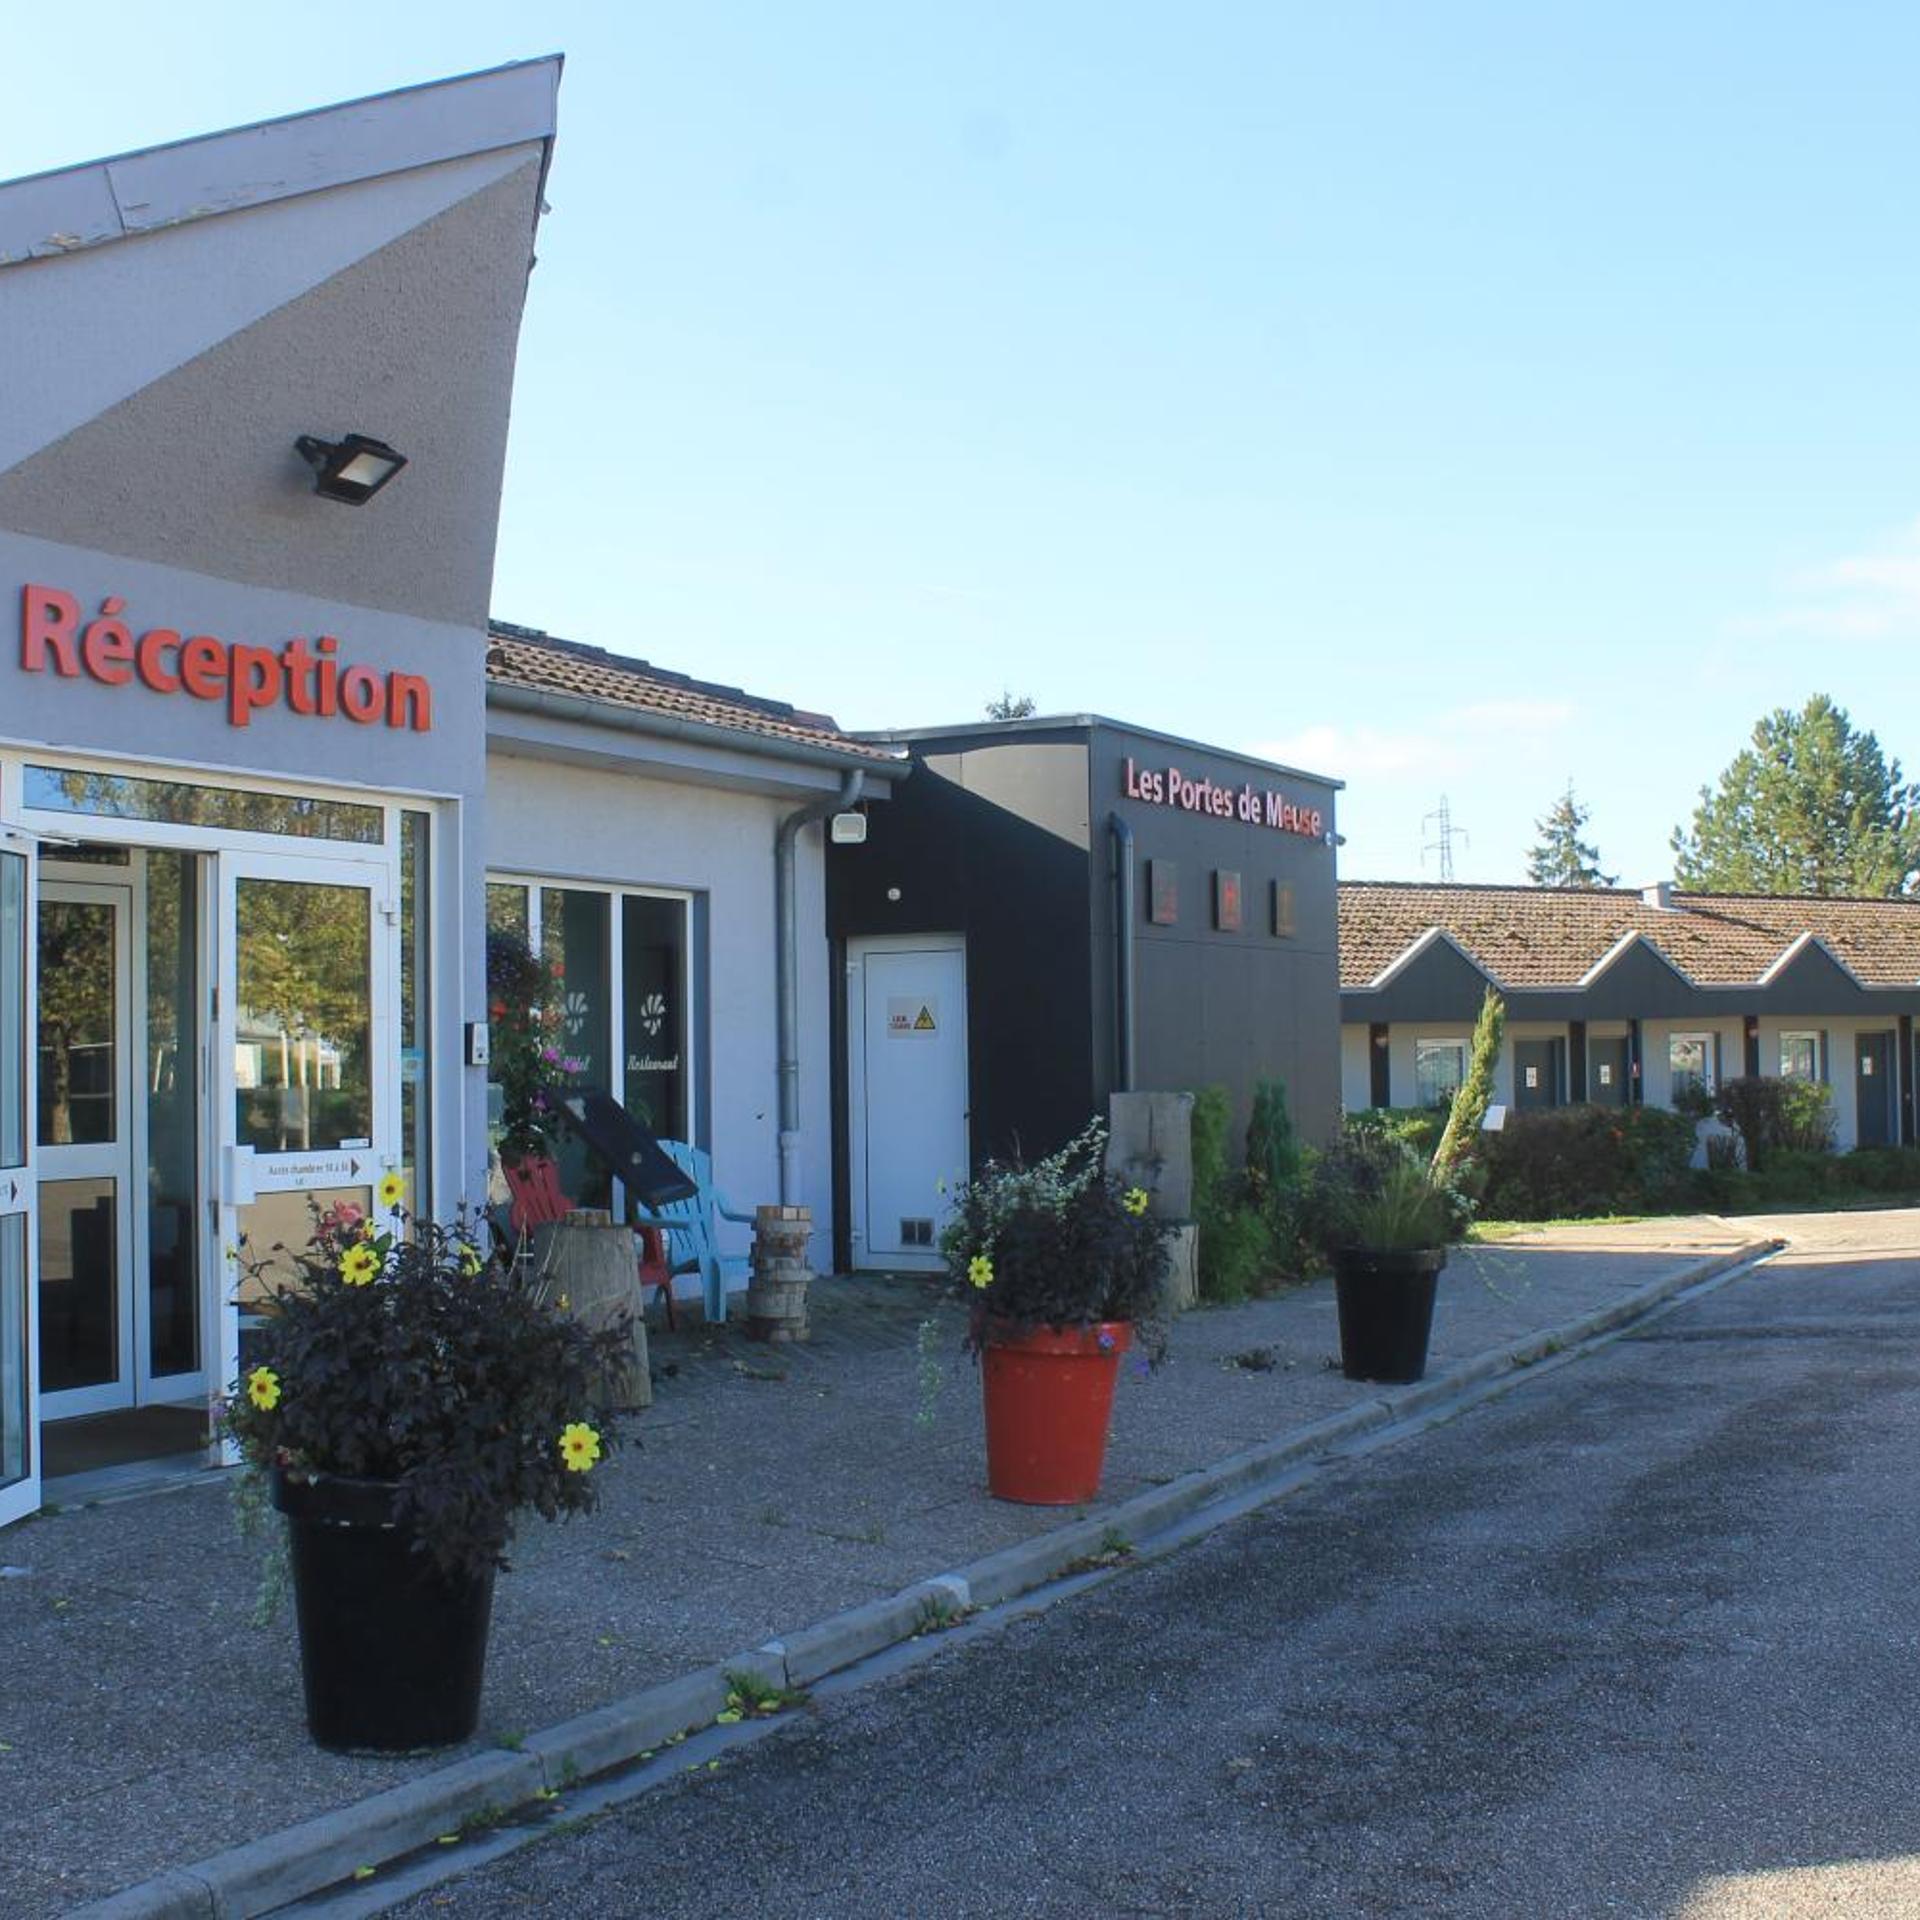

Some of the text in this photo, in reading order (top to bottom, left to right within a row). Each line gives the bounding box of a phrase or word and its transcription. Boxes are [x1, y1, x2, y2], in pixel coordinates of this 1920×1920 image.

[21, 583, 432, 732] Réception
[1125, 757, 1321, 837] Les Portes de Meuse
